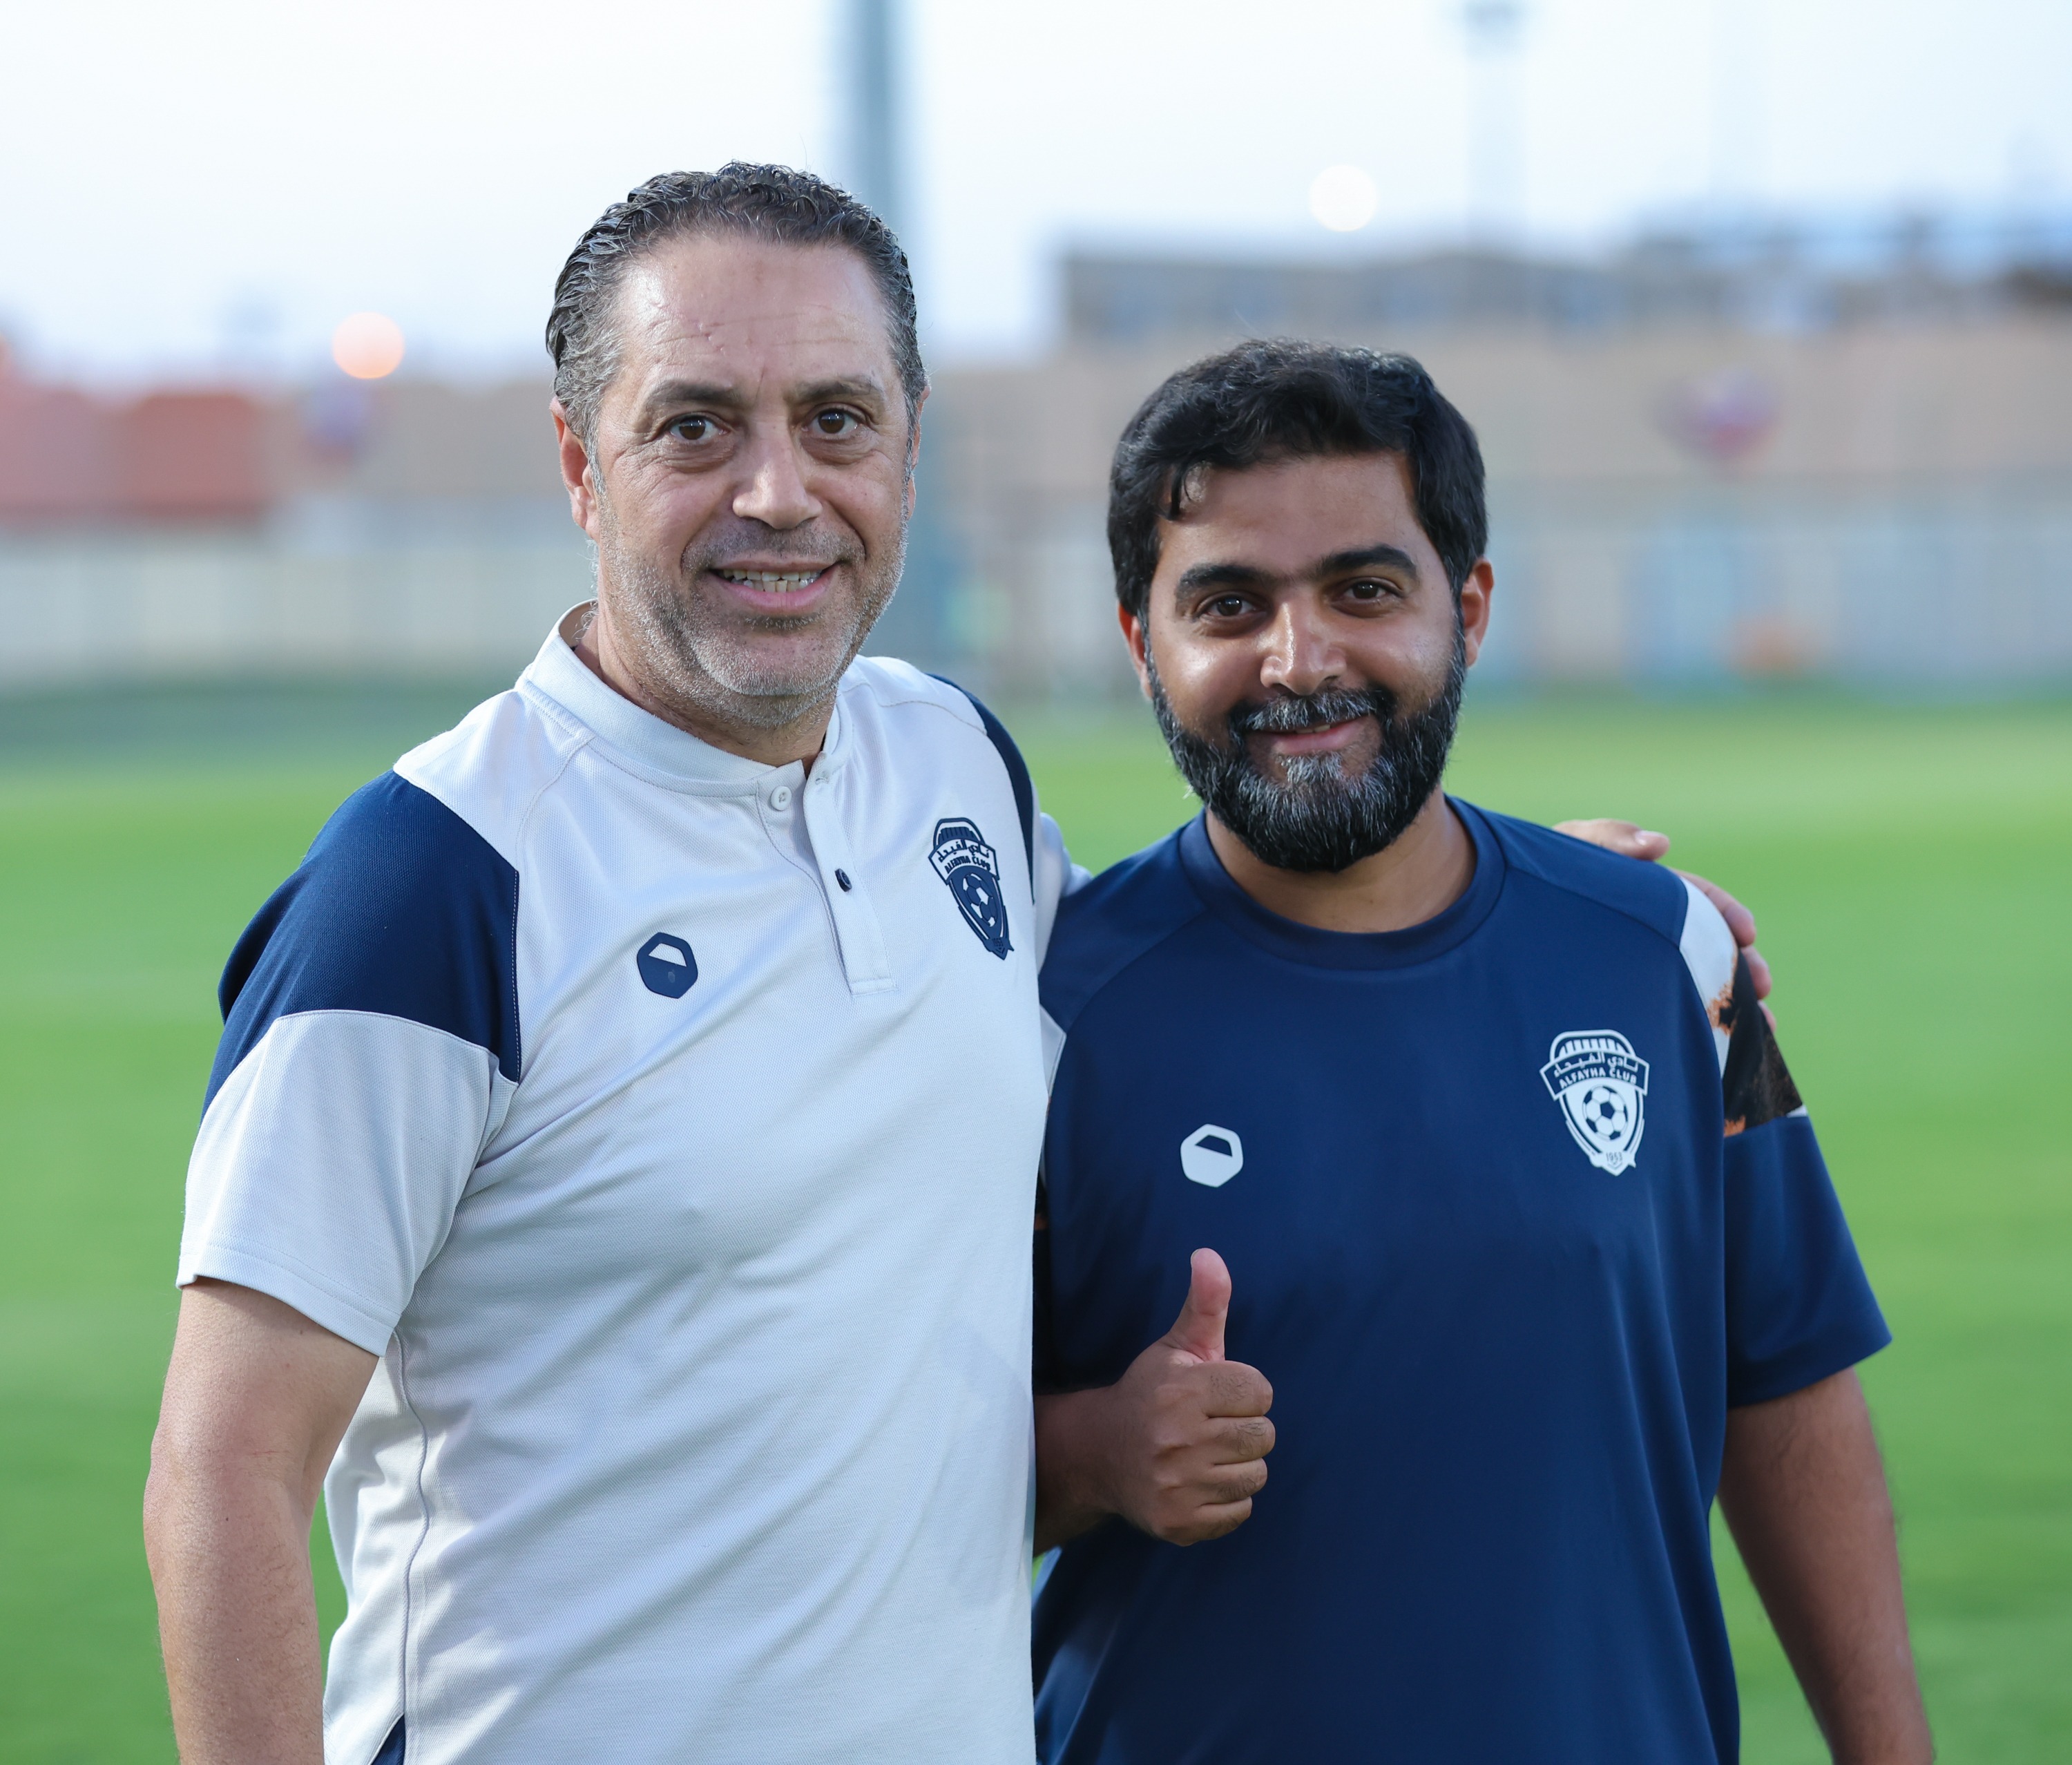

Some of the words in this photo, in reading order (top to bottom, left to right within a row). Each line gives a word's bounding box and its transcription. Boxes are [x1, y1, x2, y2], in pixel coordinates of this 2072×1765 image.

[972, 856, 990, 871] CLUB
[1559, 1067, 1606, 1089] ALFAYHA
[1609, 1067, 1637, 1085] CLUB
